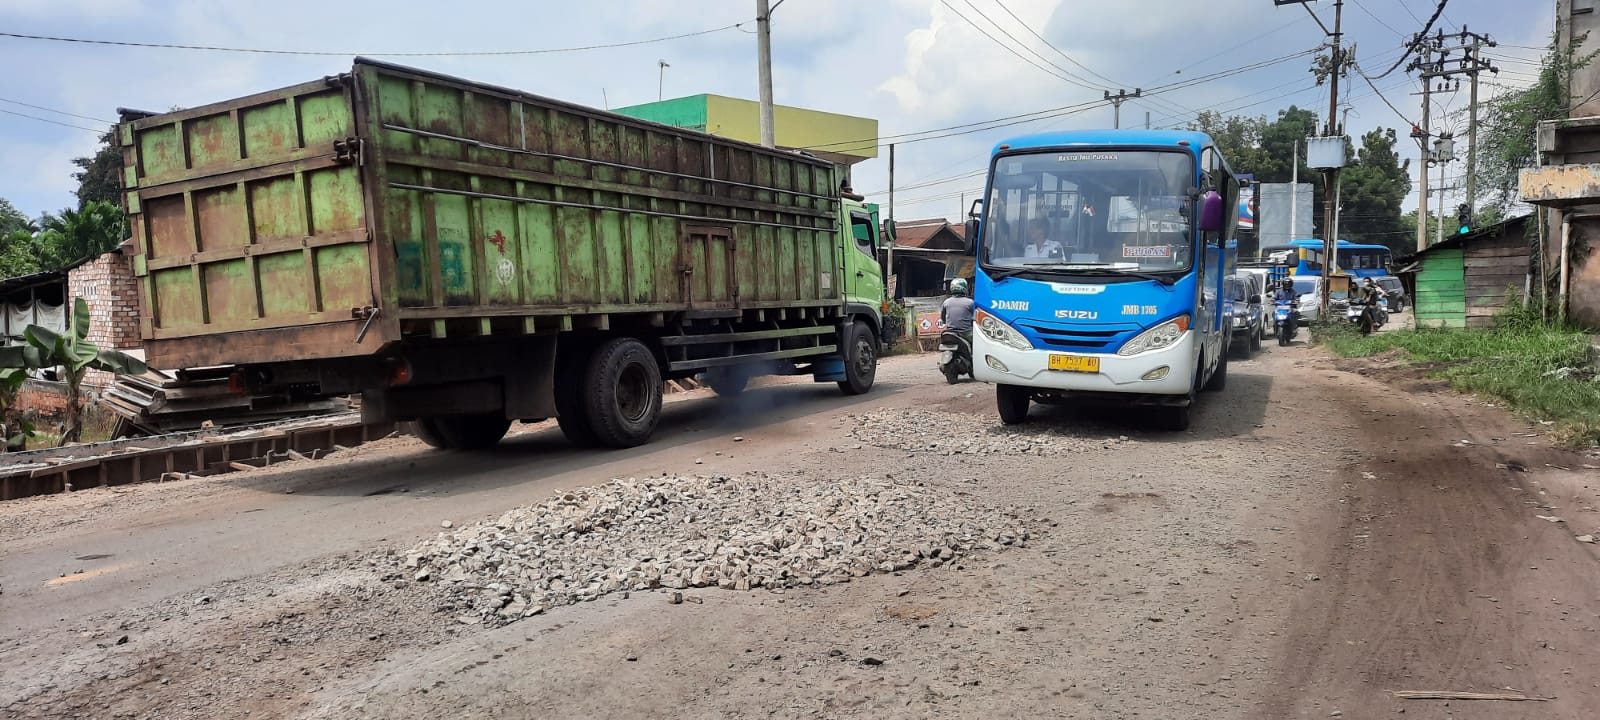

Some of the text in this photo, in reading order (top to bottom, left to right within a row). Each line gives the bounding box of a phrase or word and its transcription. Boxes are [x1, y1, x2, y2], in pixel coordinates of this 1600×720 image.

[998, 299, 1029, 311] DAMRI
[1121, 304, 1140, 315] JMB
[1055, 309, 1098, 320] ISUZU
[1051, 355, 1061, 365] BH
